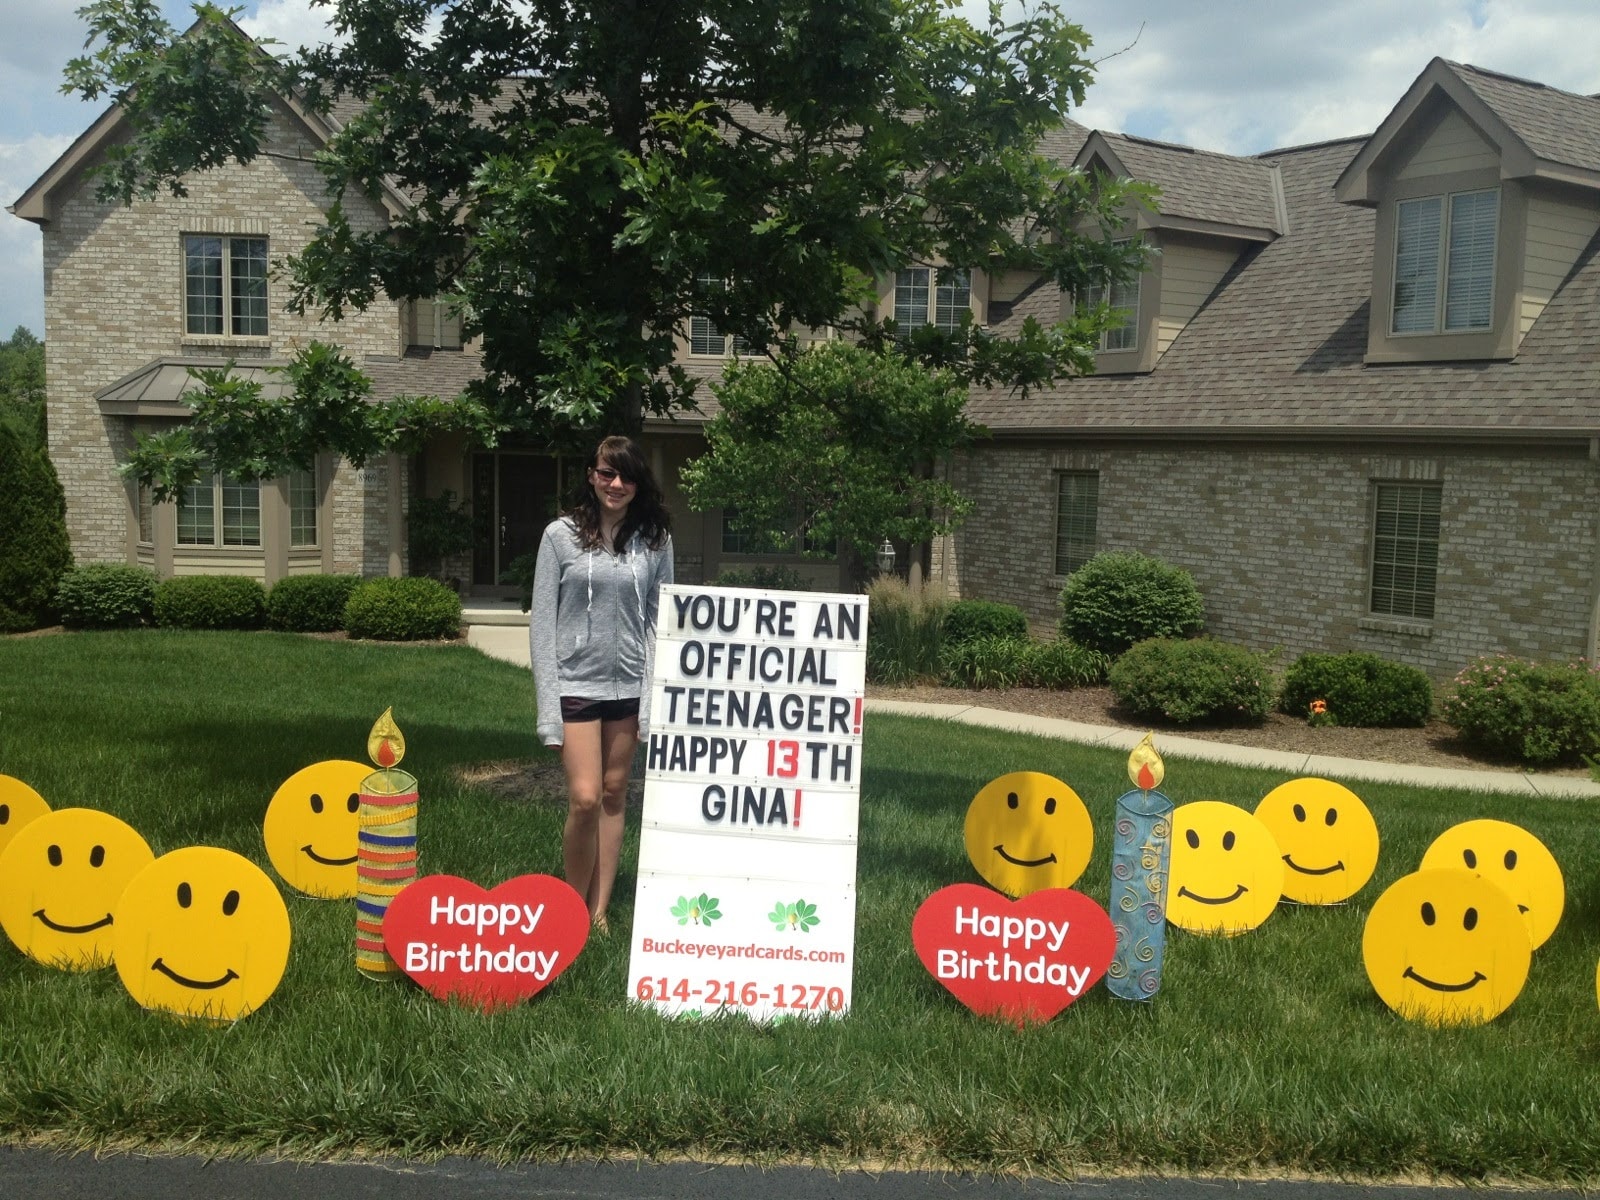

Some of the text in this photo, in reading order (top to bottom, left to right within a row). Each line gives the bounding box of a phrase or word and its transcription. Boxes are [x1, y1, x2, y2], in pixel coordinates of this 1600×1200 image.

[673, 594, 861, 640] YOU'RE AN
[680, 640, 837, 685] OFFICIAL
[664, 686, 862, 734] TEENAGER!
[648, 734, 853, 781] HAPPY 13TH
[701, 784, 802, 827] GINA!
[430, 896, 545, 936] Happy
[955, 906, 1069, 951] Happy
[405, 942, 559, 981] Birthday
[642, 938, 845, 963] Buckeyeyardcards.com
[937, 949, 1091, 996] Birthday
[636, 976, 844, 1011] 614-216-1270
